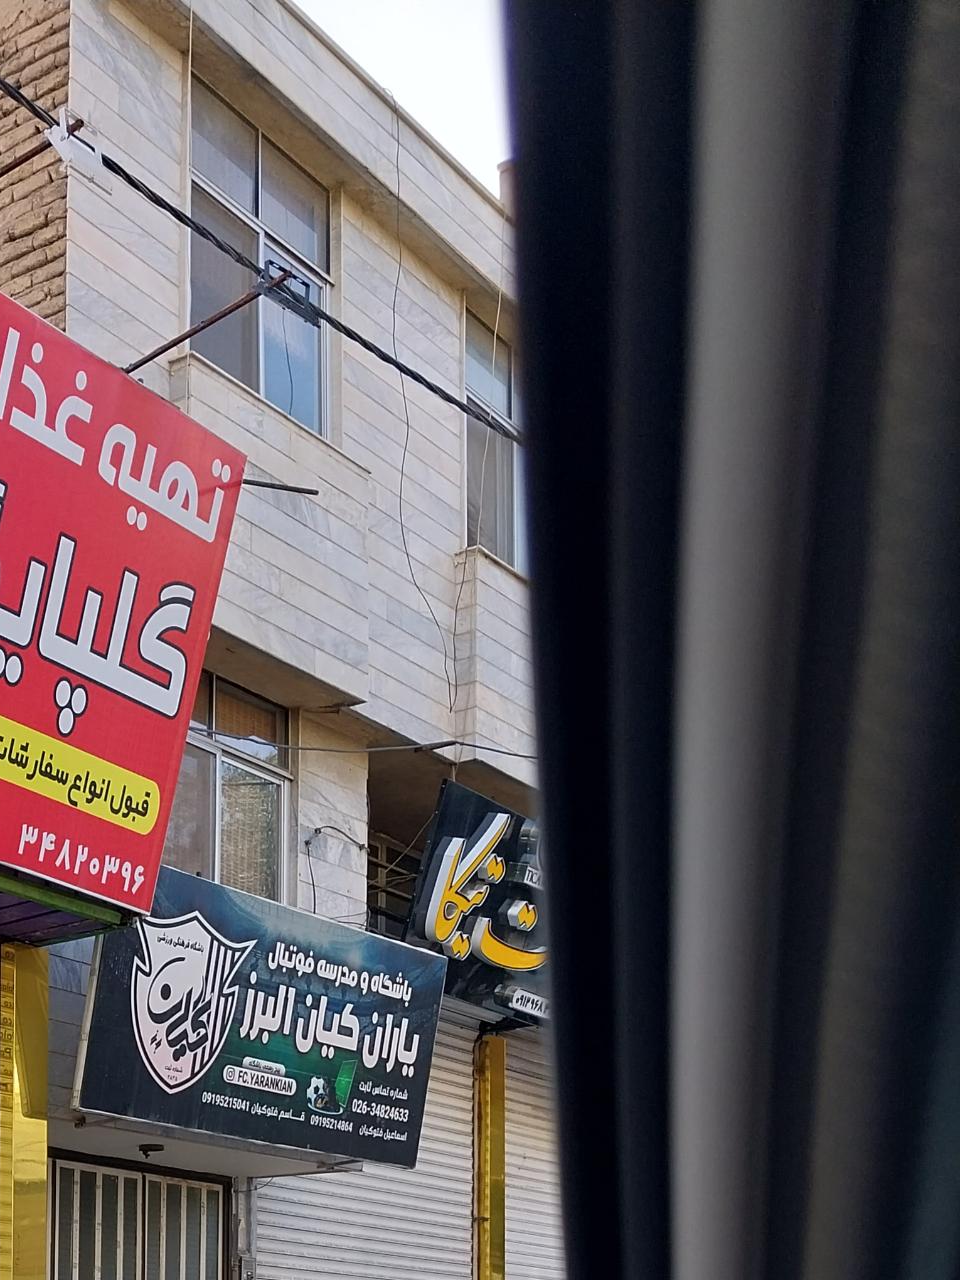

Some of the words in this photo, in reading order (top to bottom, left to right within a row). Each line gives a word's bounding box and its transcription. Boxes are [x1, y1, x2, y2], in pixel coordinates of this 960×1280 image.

[98, 422, 233, 543] تهیه
[68, 771, 111, 807] انواع
[109, 785, 151, 822] قبول
[18, 823, 145, 894] ۳۴۸۲۰۳۹۶
[268, 942, 315, 977] فوتبال
[316, 959, 358, 987] مدرسه
[360, 971, 369, 995] و
[240, 971, 296, 1044] البرز
[295, 993, 360, 1060] کیان
[362, 1011, 420, 1078] یاران
[237, 1070, 293, 1093] FC.YARANKIAN
[372, 1084, 390, 1096] تماس
[390, 1088, 408, 1100] شماره
[201, 1091, 250, 1112] 09195215041
[352, 1101, 409, 1123] 026-34824633
[310, 1114, 353, 1133] 09195214864
